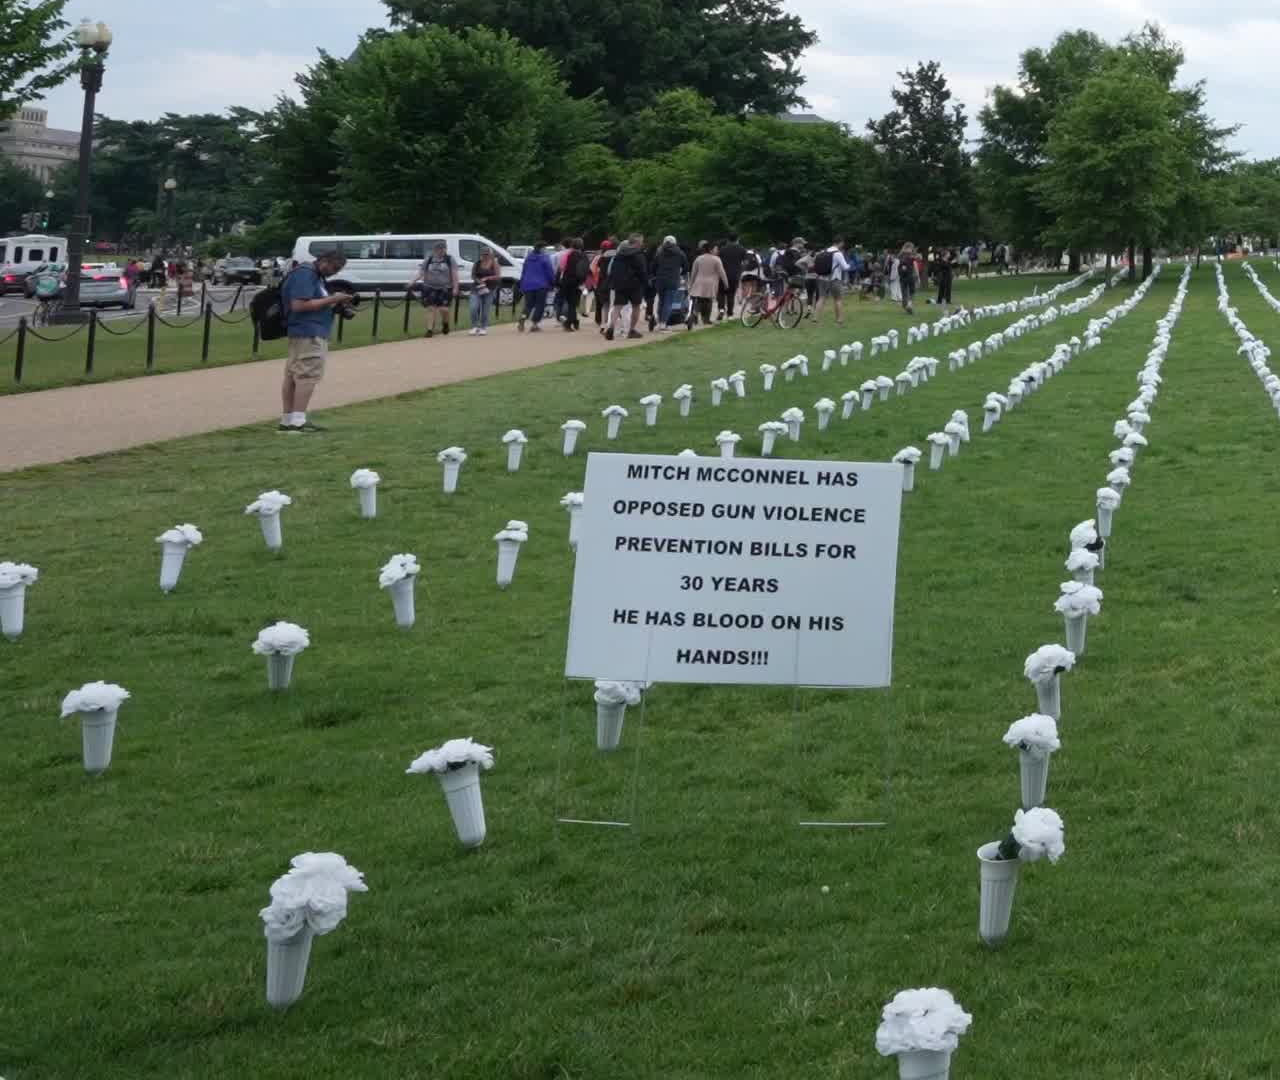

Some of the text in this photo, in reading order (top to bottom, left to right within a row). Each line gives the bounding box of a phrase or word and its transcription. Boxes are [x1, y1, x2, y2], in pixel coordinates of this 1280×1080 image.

[628, 465, 857, 486] MITCH MCCONNEL HAS
[614, 500, 865, 522] OPPOSED GUN VIOLENCE
[616, 537, 856, 558] PREVENTION BILLS FOR
[681, 576, 778, 592] 30 YEARS
[614, 610, 843, 630] HE HAS BLOOD ON HIS
[677, 650, 768, 665] HANDS!!!
